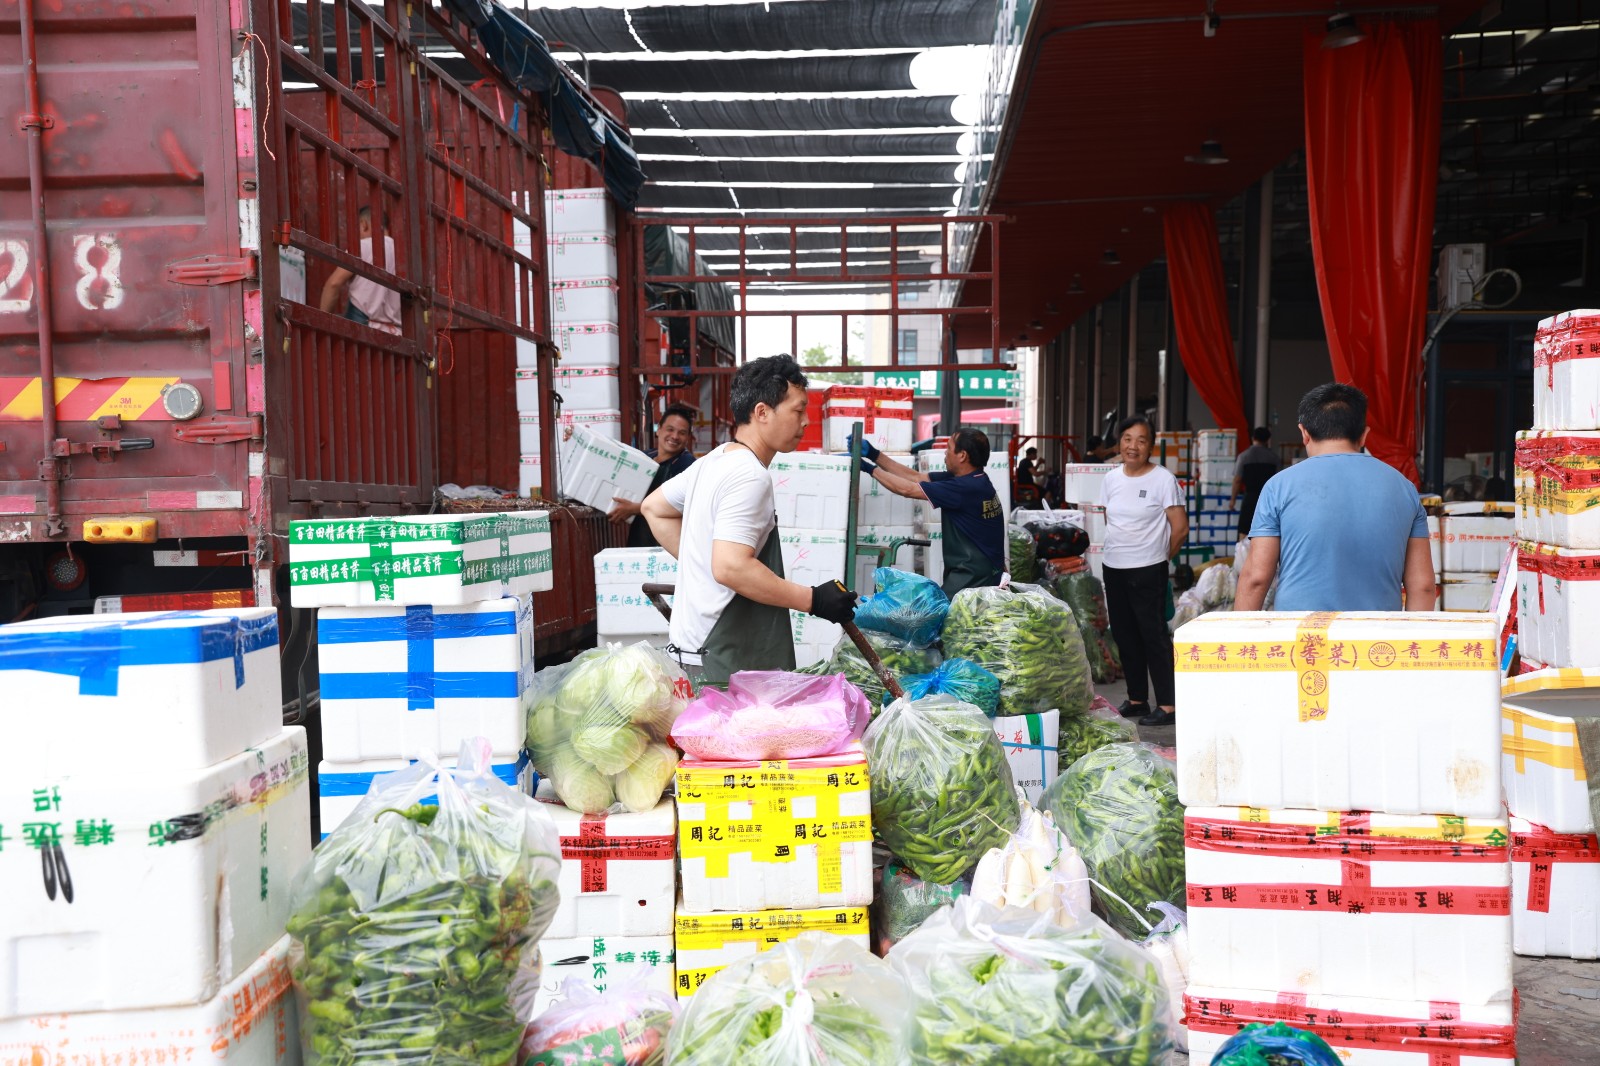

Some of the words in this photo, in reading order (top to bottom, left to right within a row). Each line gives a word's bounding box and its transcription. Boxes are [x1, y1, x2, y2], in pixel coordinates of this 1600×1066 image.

[294, 524, 366, 542] 百亩田精品香芹
[290, 561, 360, 582] 百亩田精品香芹
[371, 555, 443, 577] 百亩田精品香芹
[1401, 641, 1497, 659] 青青精
[691, 826, 723, 842] 周記
[728, 825, 763, 833] 精品蔬菜
[794, 823, 827, 840] 周記
[832, 820, 866, 829] 精品蔬菜
[1418, 891, 1454, 908] 湘玉
